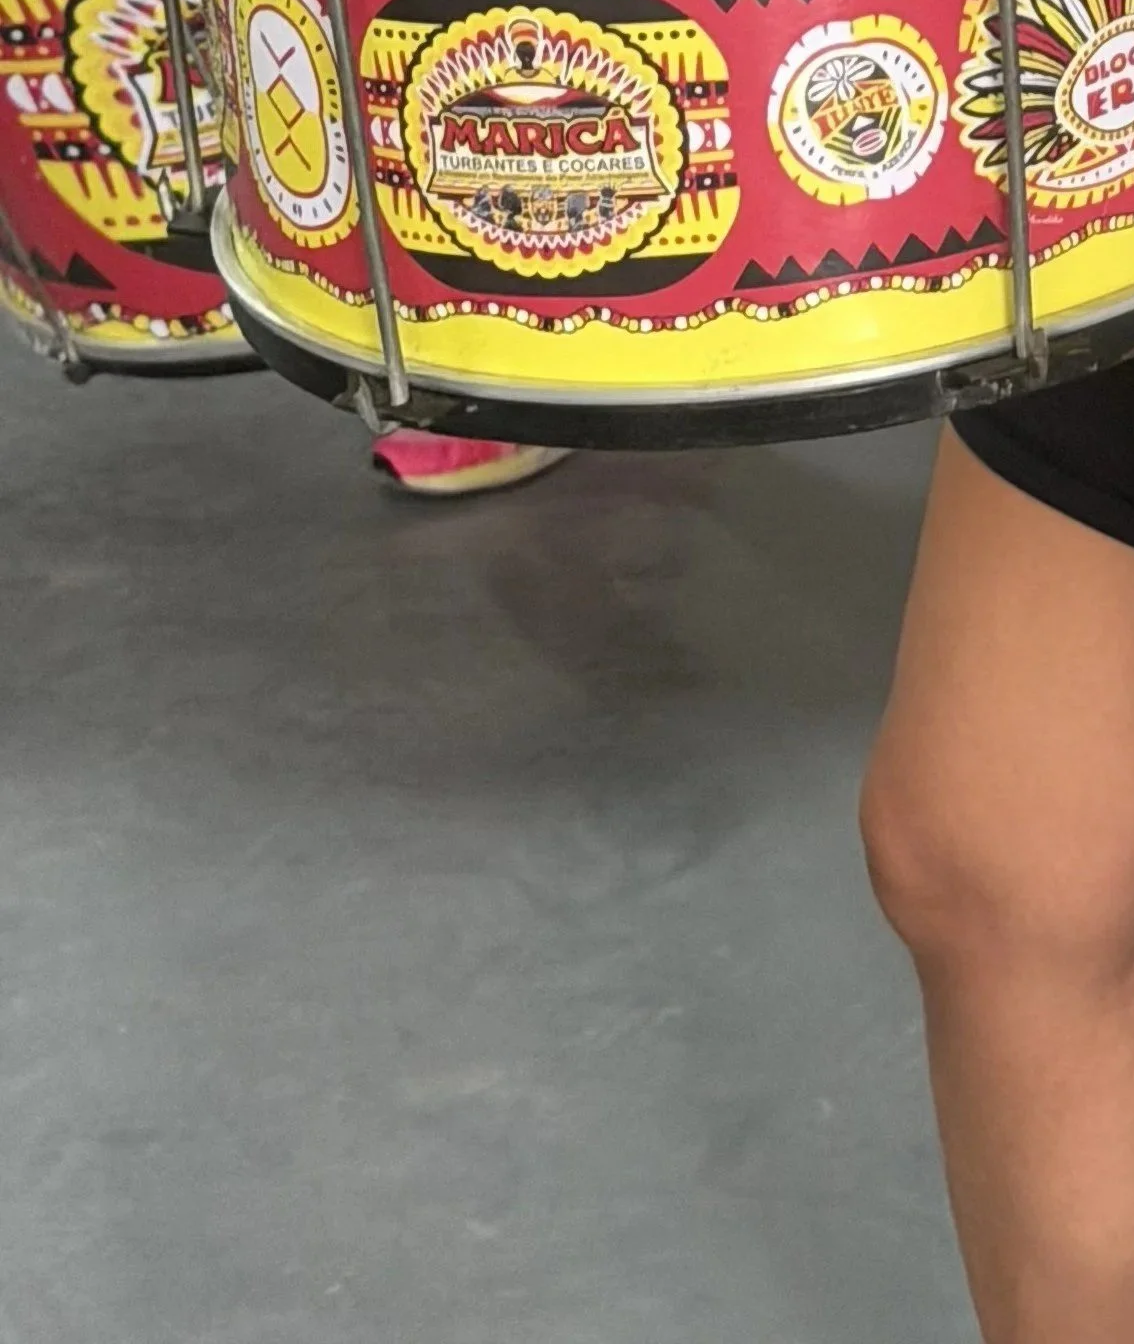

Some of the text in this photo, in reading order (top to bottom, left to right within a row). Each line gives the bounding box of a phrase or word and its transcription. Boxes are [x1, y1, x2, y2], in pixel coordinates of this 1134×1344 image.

[439, 107, 642, 159] MARICÁ
[439, 154, 646, 173] TURBANTES E COCARES
